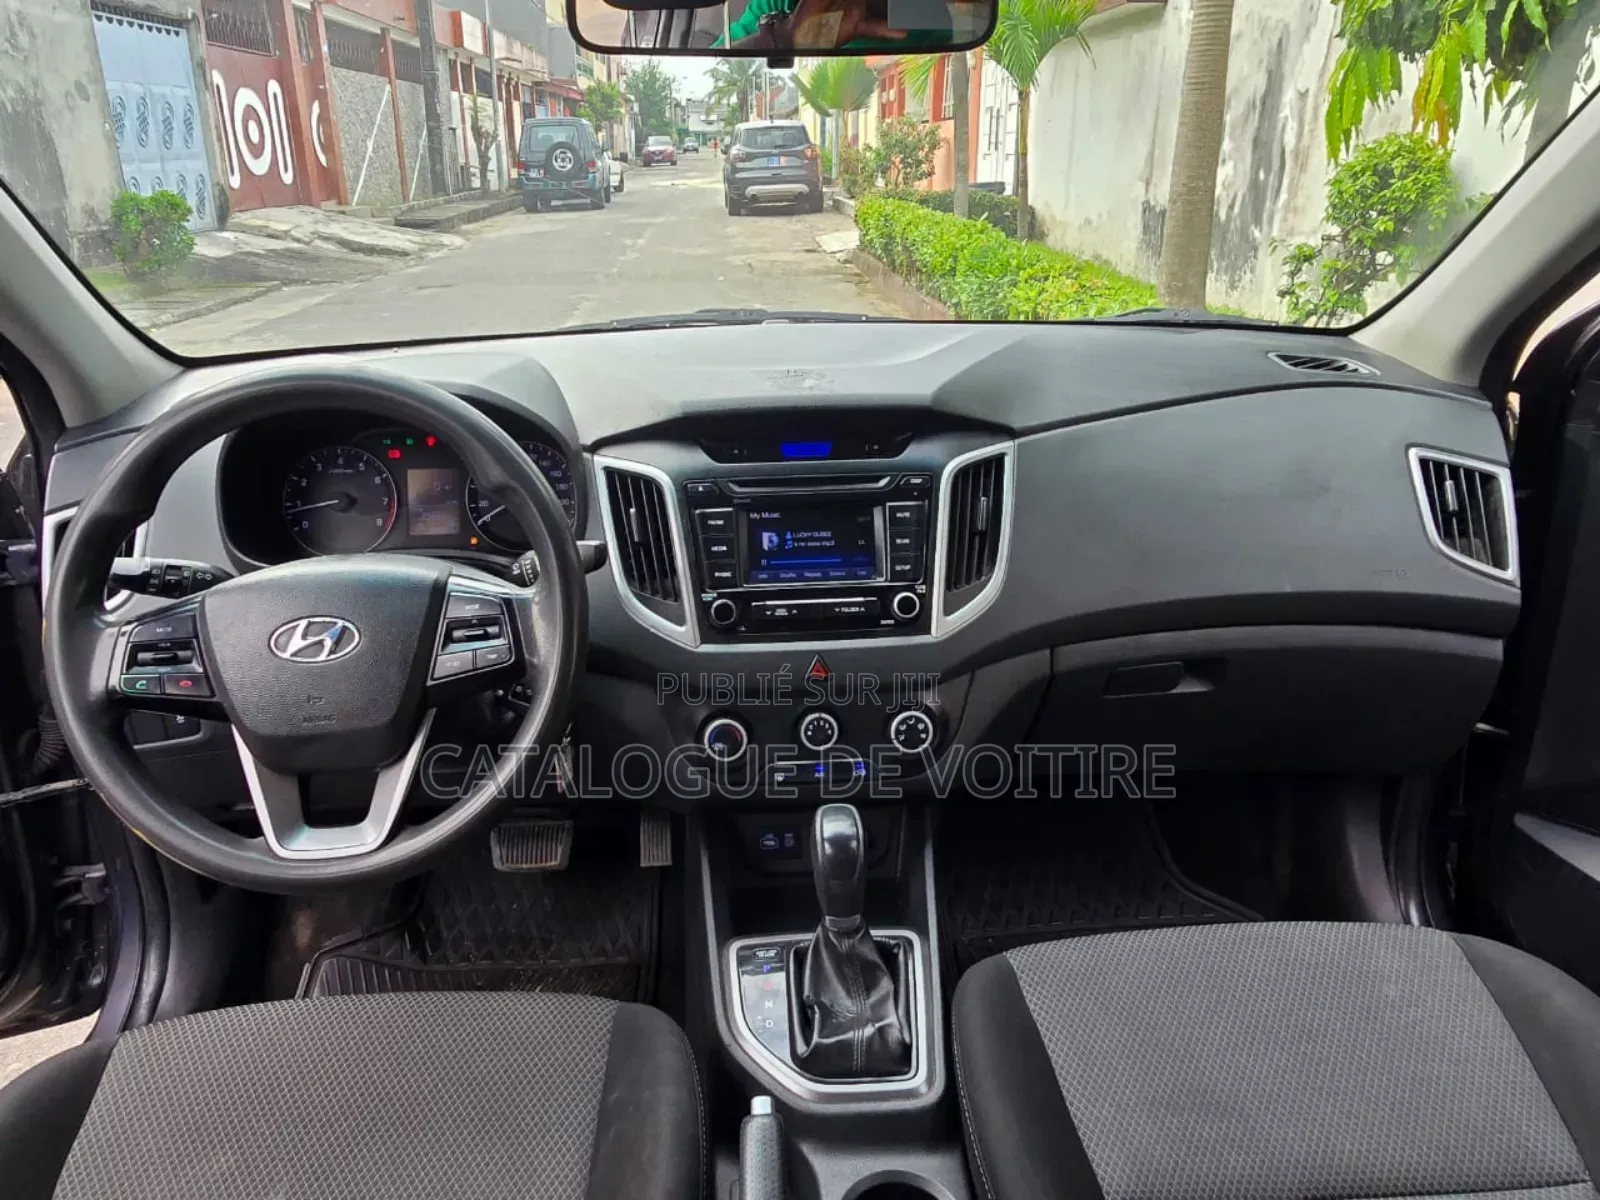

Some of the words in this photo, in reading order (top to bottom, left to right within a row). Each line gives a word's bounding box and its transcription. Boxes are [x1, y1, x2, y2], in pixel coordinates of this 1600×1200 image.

[750, 511, 760, 519] My
[763, 964, 771, 973] P
[764, 1000, 773, 1009] N
[765, 1019, 774, 1029] D
